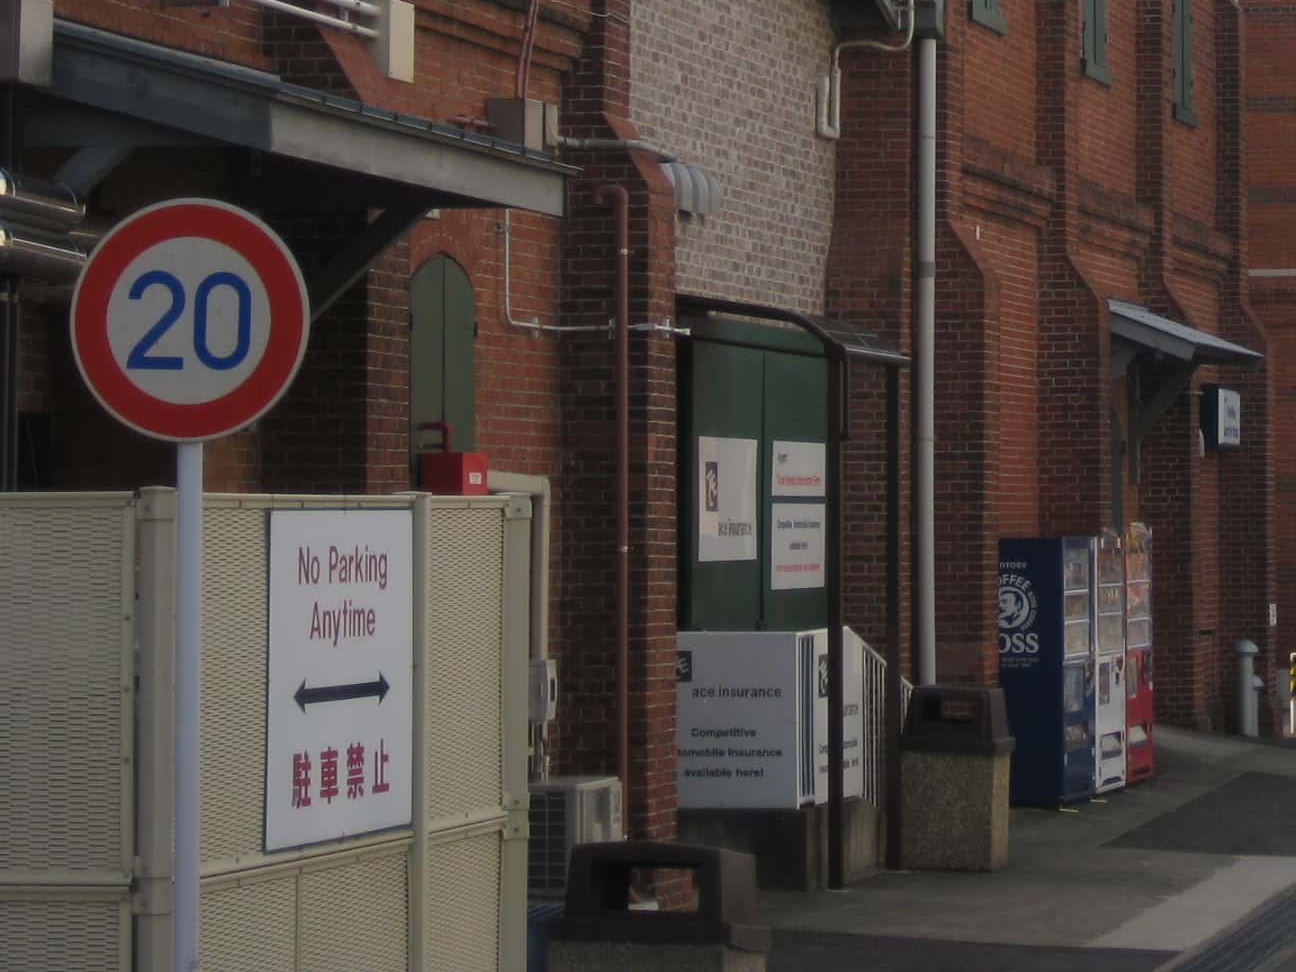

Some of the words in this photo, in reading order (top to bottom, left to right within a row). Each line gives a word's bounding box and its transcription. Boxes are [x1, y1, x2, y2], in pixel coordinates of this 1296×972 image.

[126, 270, 252, 370] 20
[298, 546, 320, 585] No
[328, 545, 388, 590] Parking
[310, 600, 376, 647] Anytime
[692, 688, 715, 698] ace
[718, 685, 783, 698] insurance
[691, 727, 757, 738] Competitive
[291, 739, 390, 809] 駐車禁止
[684, 767, 732, 778] available
